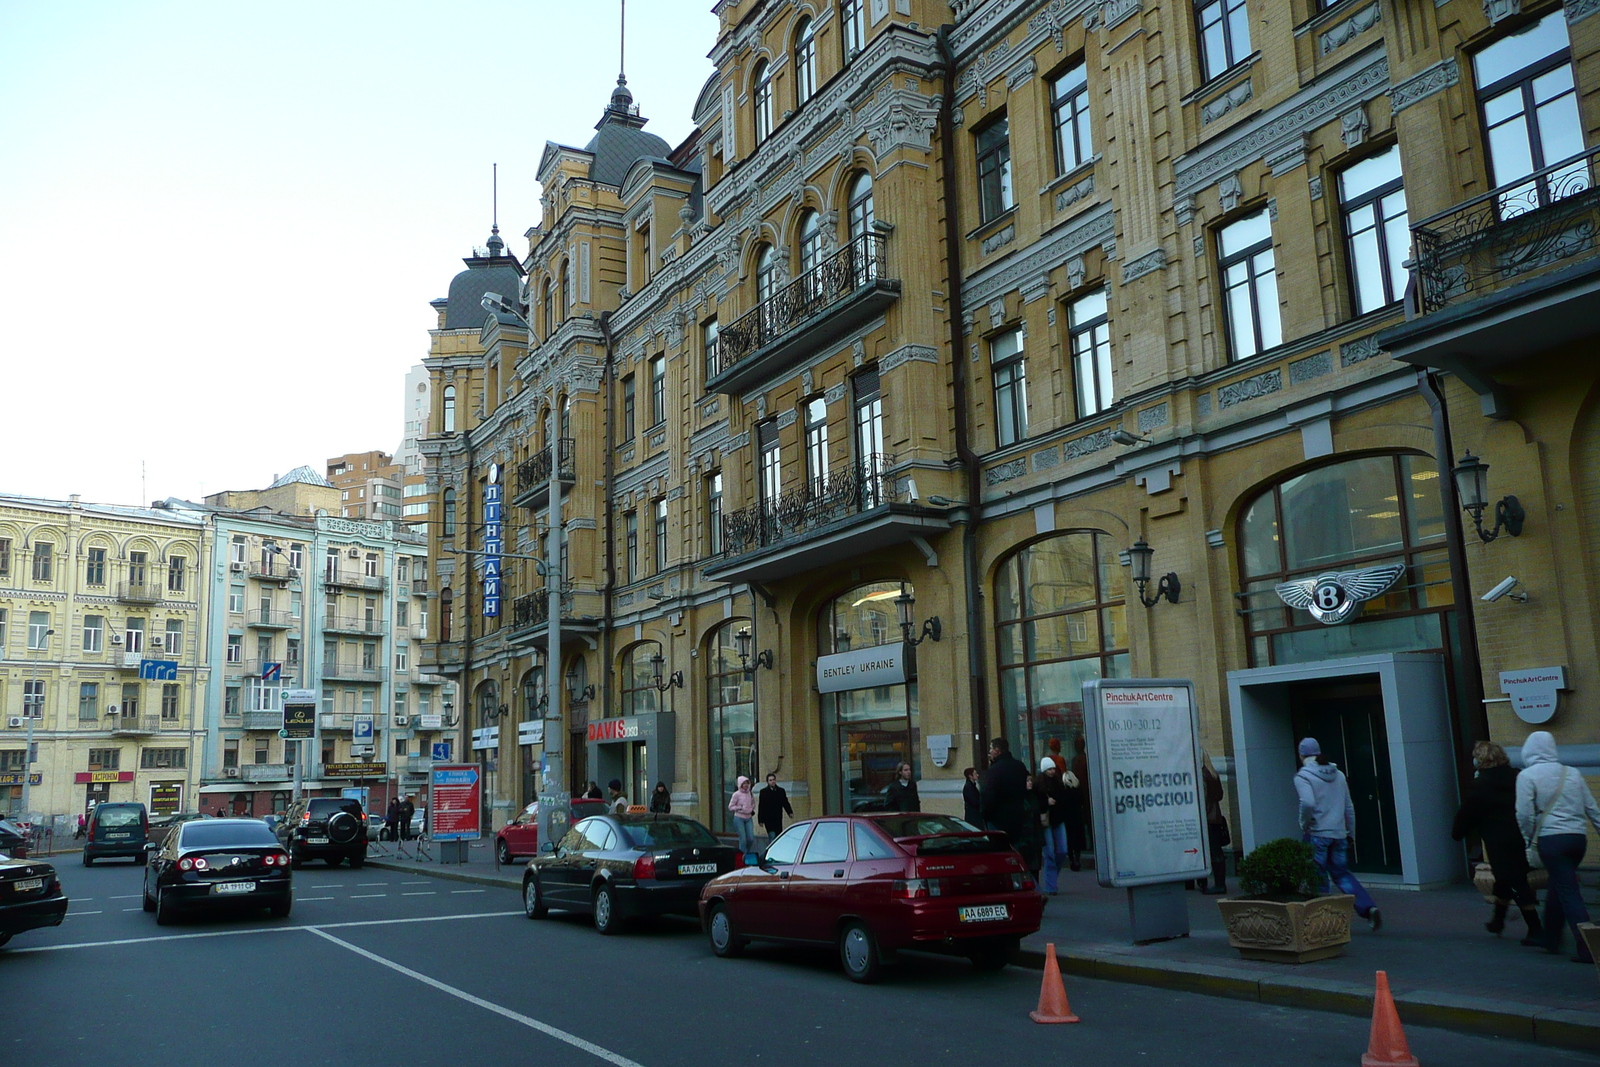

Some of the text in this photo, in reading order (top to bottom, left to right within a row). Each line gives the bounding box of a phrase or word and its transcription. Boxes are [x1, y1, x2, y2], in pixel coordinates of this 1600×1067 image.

[1317, 586, 1339, 609] B
[823, 658, 895, 679] BENTLEY UKRAINE
[1503, 675, 1558, 684] PinchukArtCentre
[1105, 692, 1174, 702] PinchukArtCentre
[358, 723, 369, 736] P
[588, 719, 626, 741] DAVIS
[92, 773, 118, 781] ГАСТРОНОМ
[1113, 770, 1192, 789] Reflection
[965, 906, 1006, 919] AA 6889 EC
